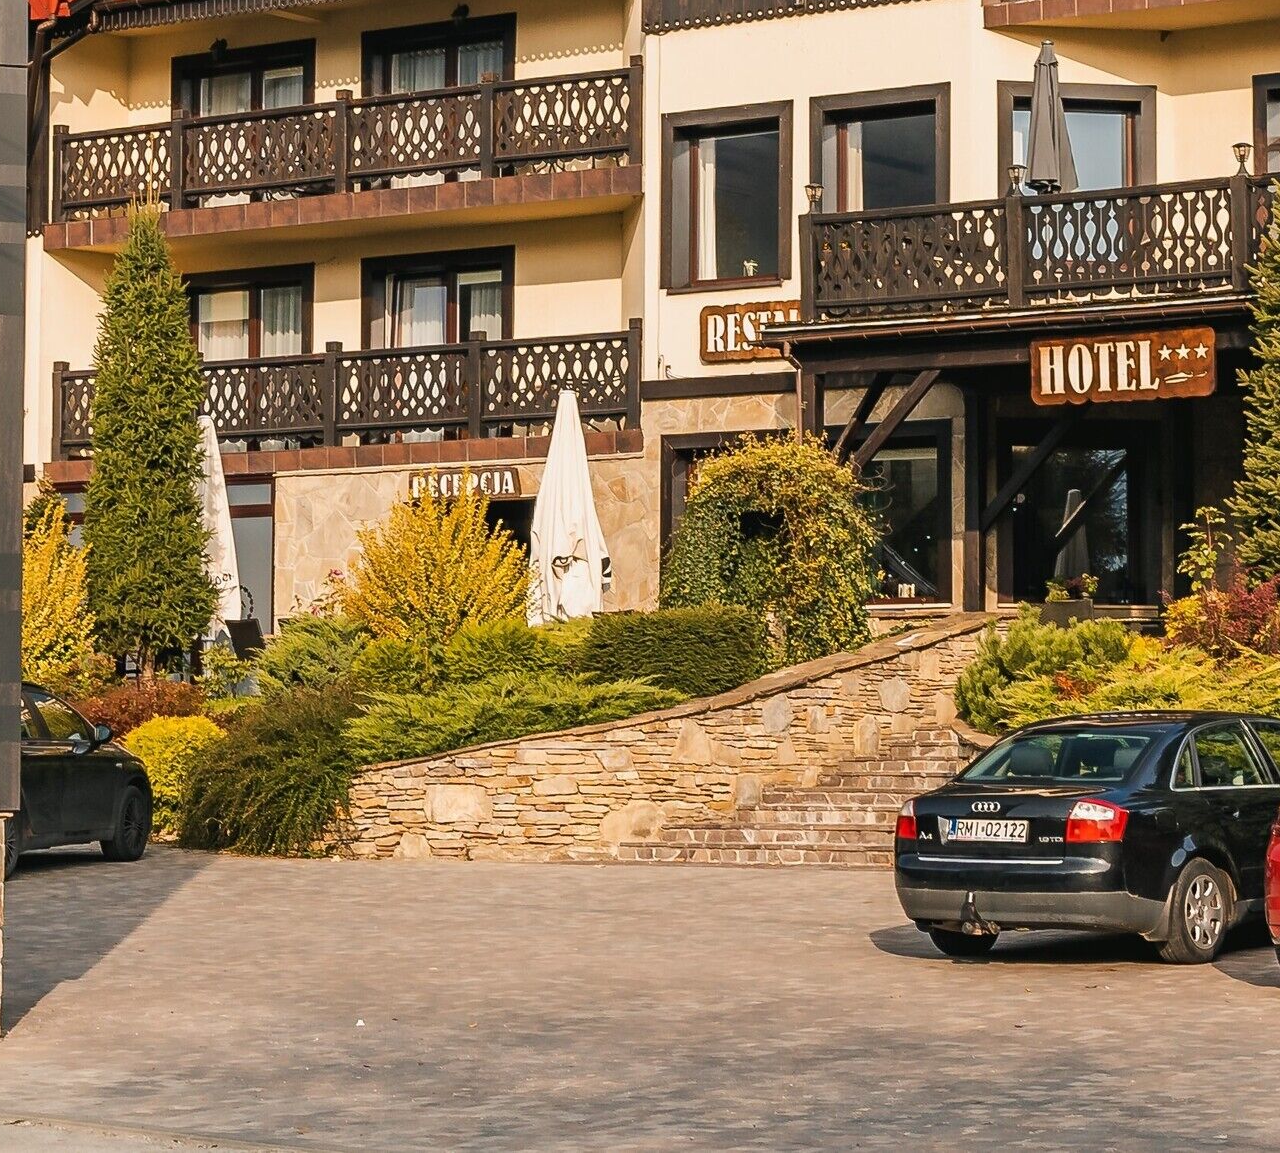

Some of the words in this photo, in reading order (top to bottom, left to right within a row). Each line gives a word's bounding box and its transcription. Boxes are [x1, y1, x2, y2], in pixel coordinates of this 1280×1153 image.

[1038, 340, 1160, 395] HOTEL
[957, 821, 979, 835] RMI
[985, 822, 1026, 838] 02122
